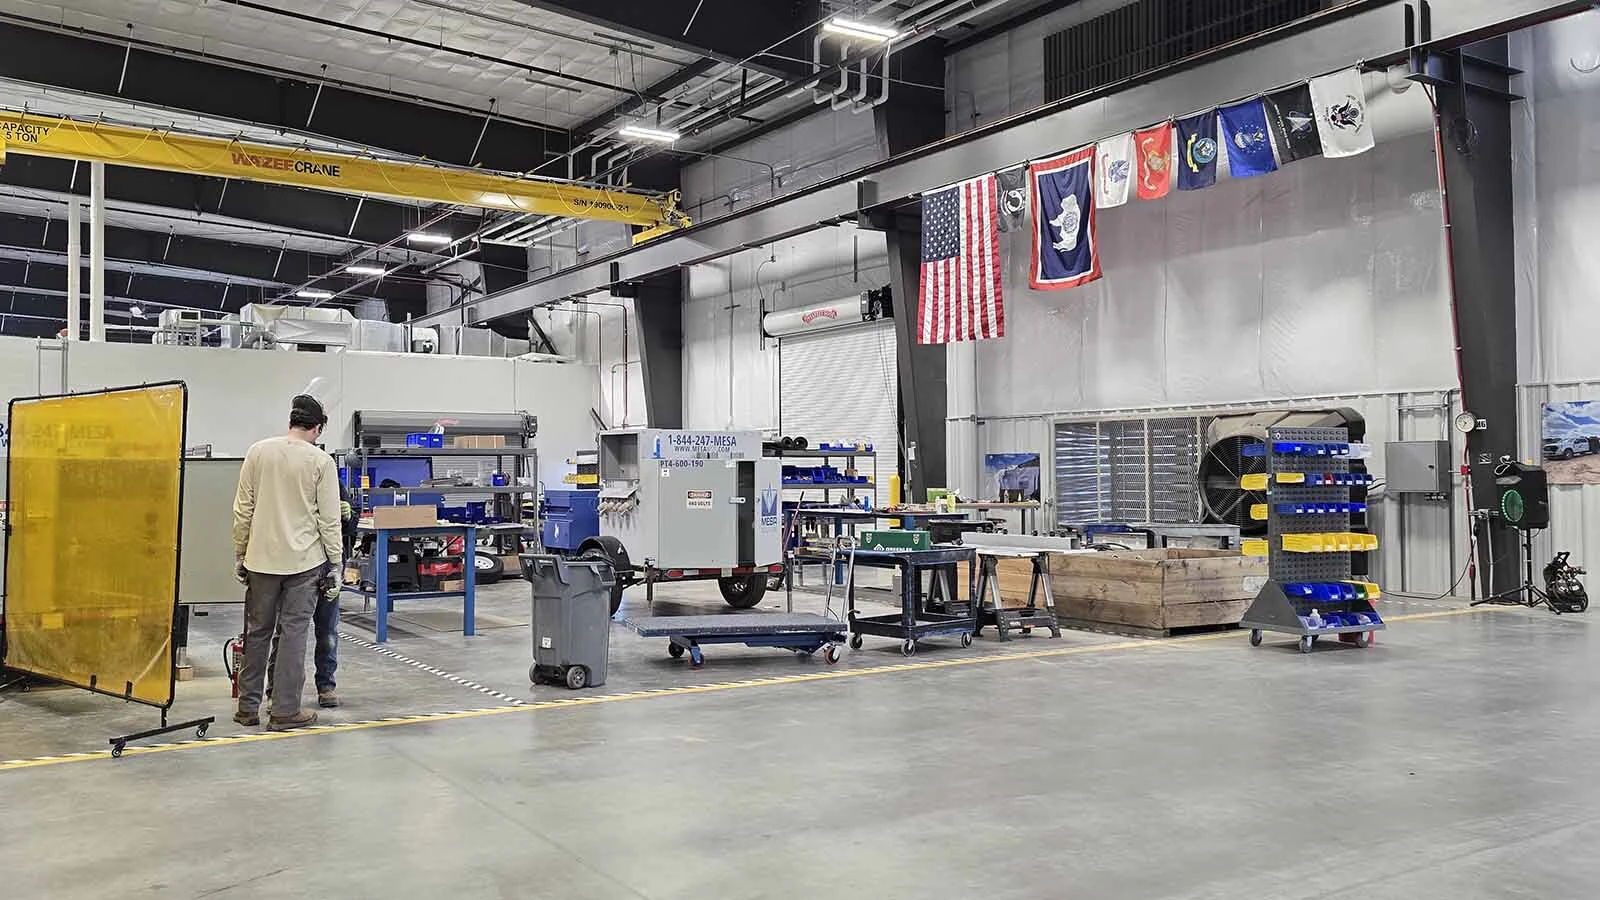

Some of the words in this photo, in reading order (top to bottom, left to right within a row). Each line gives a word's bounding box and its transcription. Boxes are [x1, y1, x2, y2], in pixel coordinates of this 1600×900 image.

[6, 131, 12, 140] 5
[15, 131, 38, 143] TON
[573, 198, 587, 207] S/N
[668, 434, 737, 447] 1-844-247-MESA
